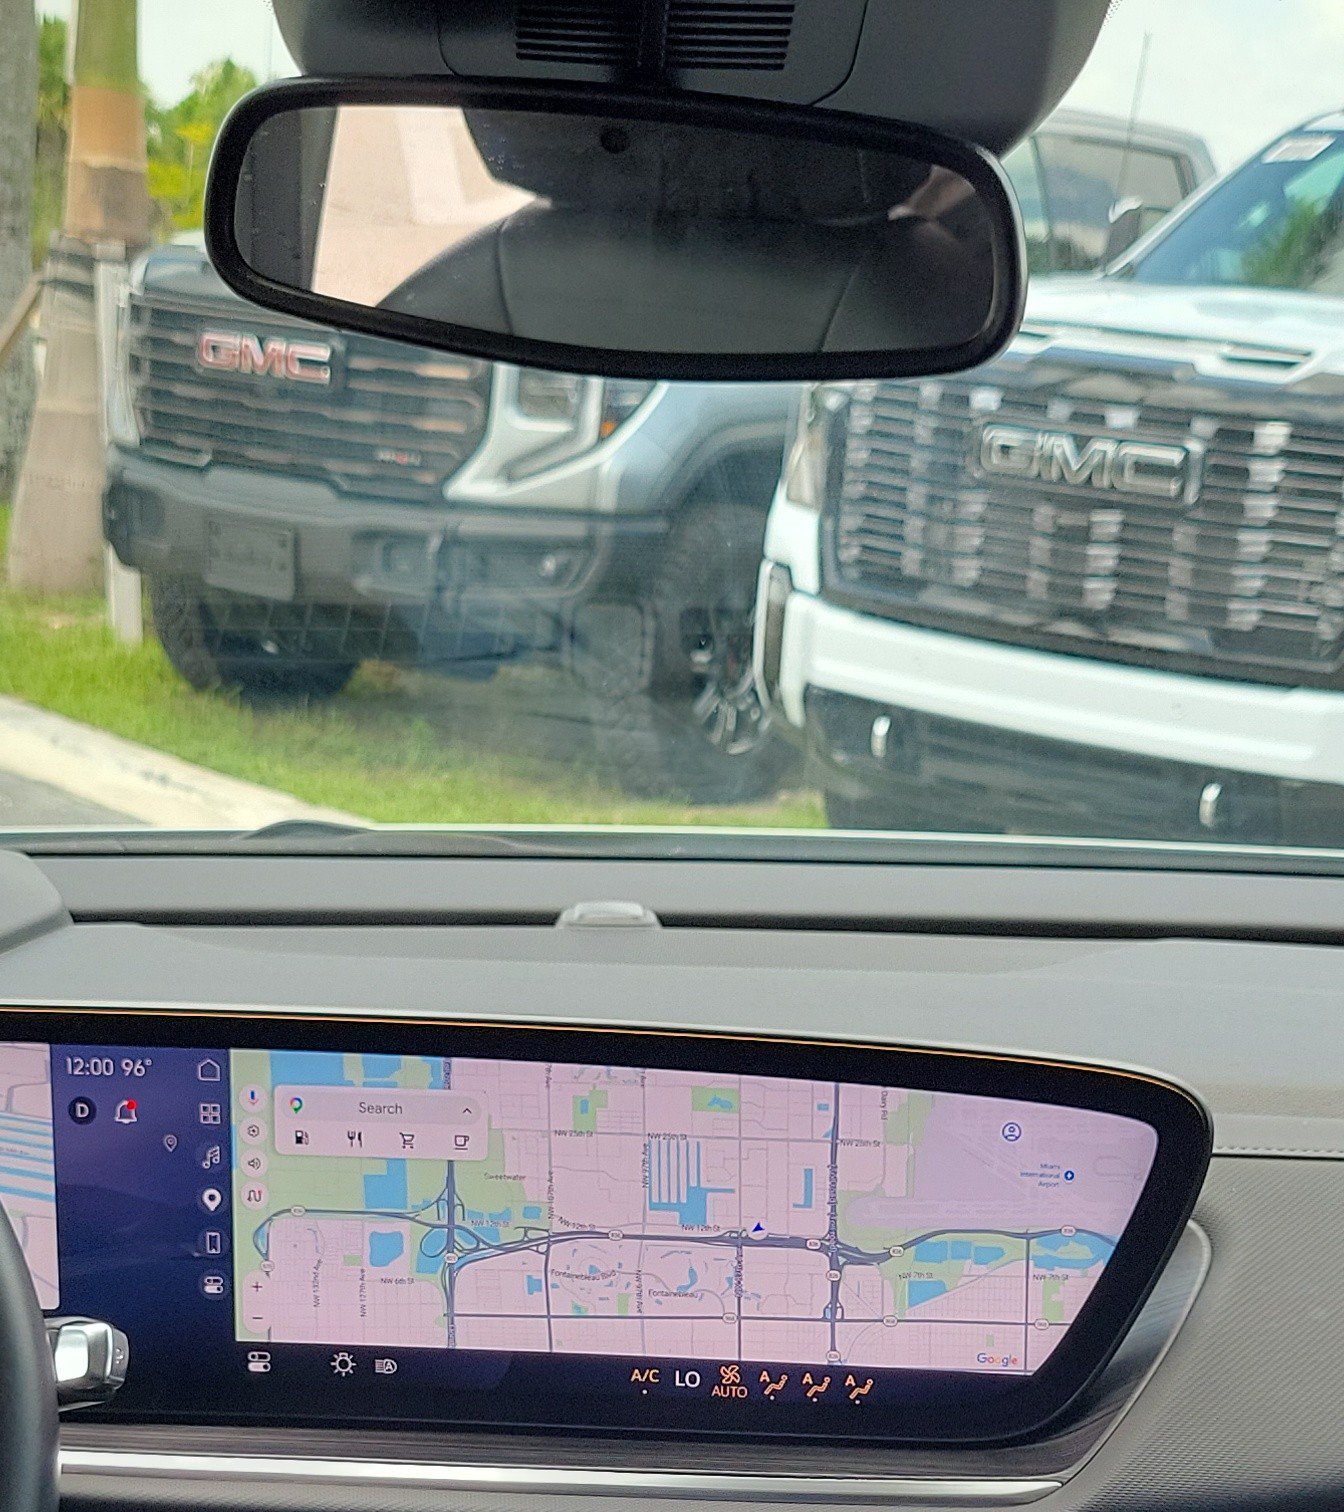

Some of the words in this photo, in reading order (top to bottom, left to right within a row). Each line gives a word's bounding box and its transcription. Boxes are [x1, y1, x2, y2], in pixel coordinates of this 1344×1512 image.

[198, 329, 332, 385] GMC
[979, 422, 1189, 498] GMC
[65, 1057, 115, 1077] 12:00
[120, 1057, 153, 1078] 96°
[75, 1102, 89, 1118] D
[358, 1101, 403, 1115] Search
[976, 1352, 1018, 1367] Google
[631, 1368, 660, 1383] A/C
[674, 1370, 701, 1388] LO
[711, 1385, 748, 1398] AUTO
